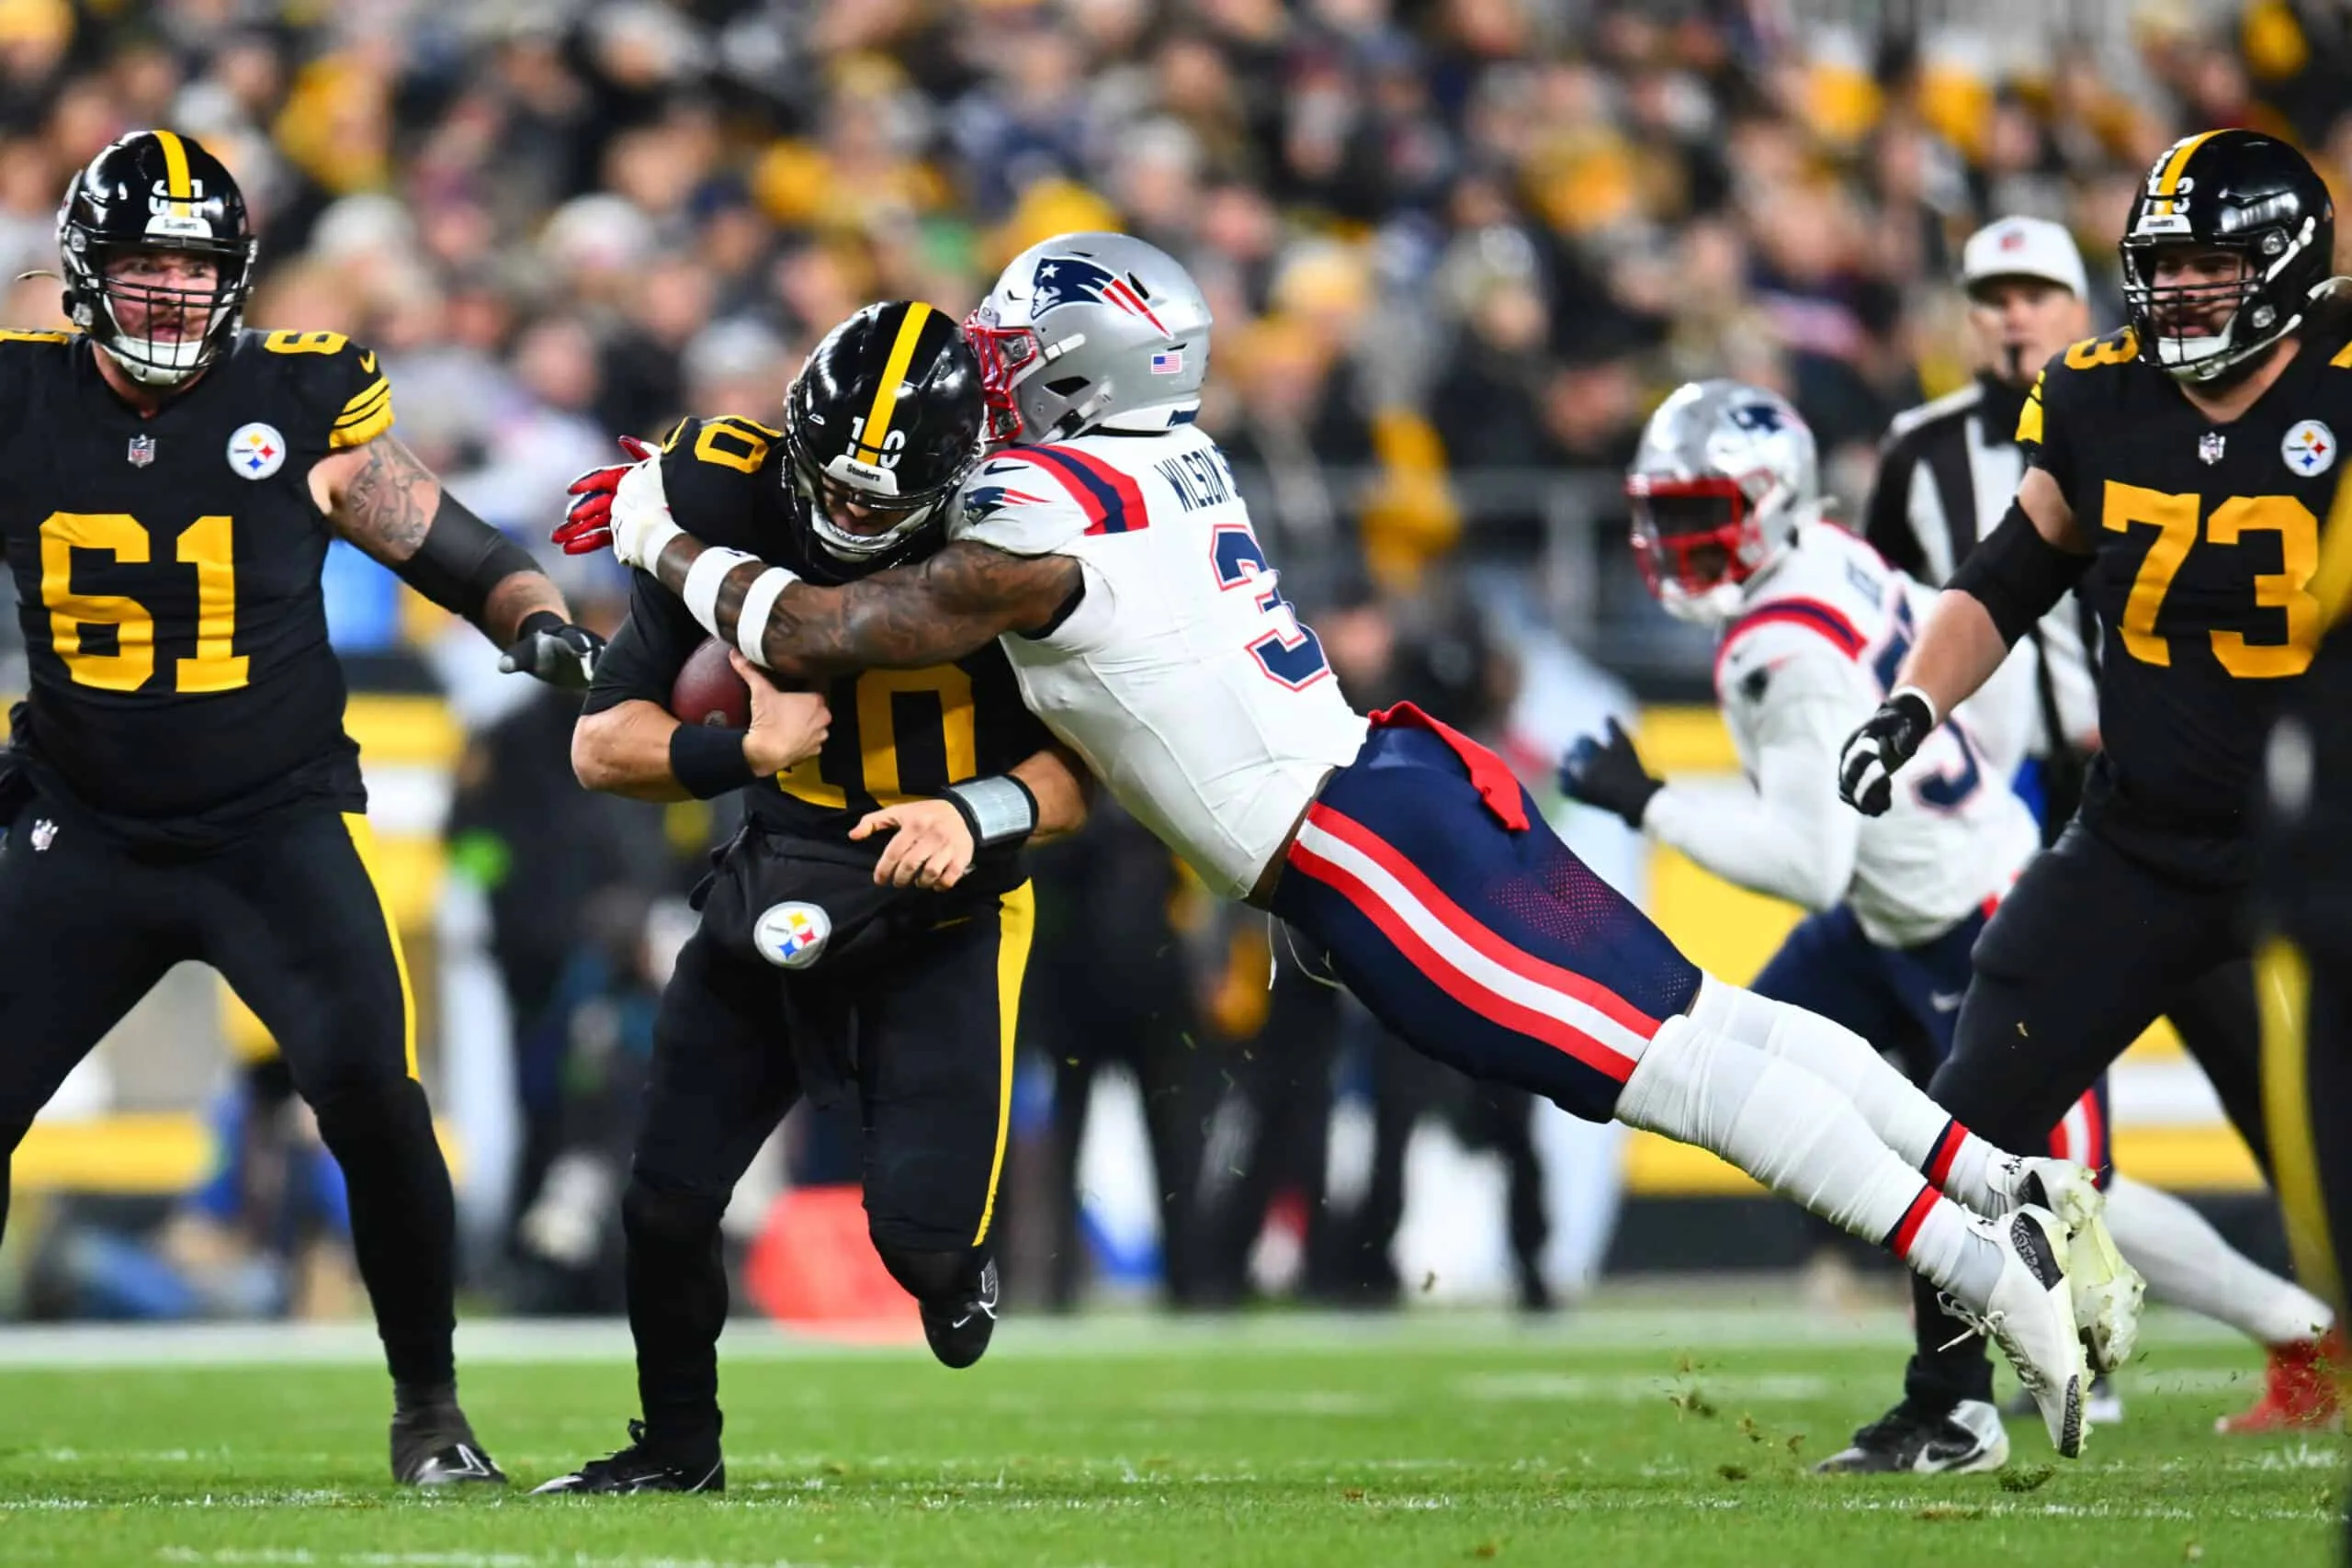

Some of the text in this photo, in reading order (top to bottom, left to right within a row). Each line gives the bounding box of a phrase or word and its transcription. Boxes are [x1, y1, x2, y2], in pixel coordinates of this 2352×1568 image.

[846, 415, 906, 469] 10
[846, 463, 881, 482] Steelers
[1153, 447, 1231, 513] WILSON
[39, 511, 251, 693] 61
[2101, 479, 2320, 678] 73
[775, 663, 977, 810] 0
